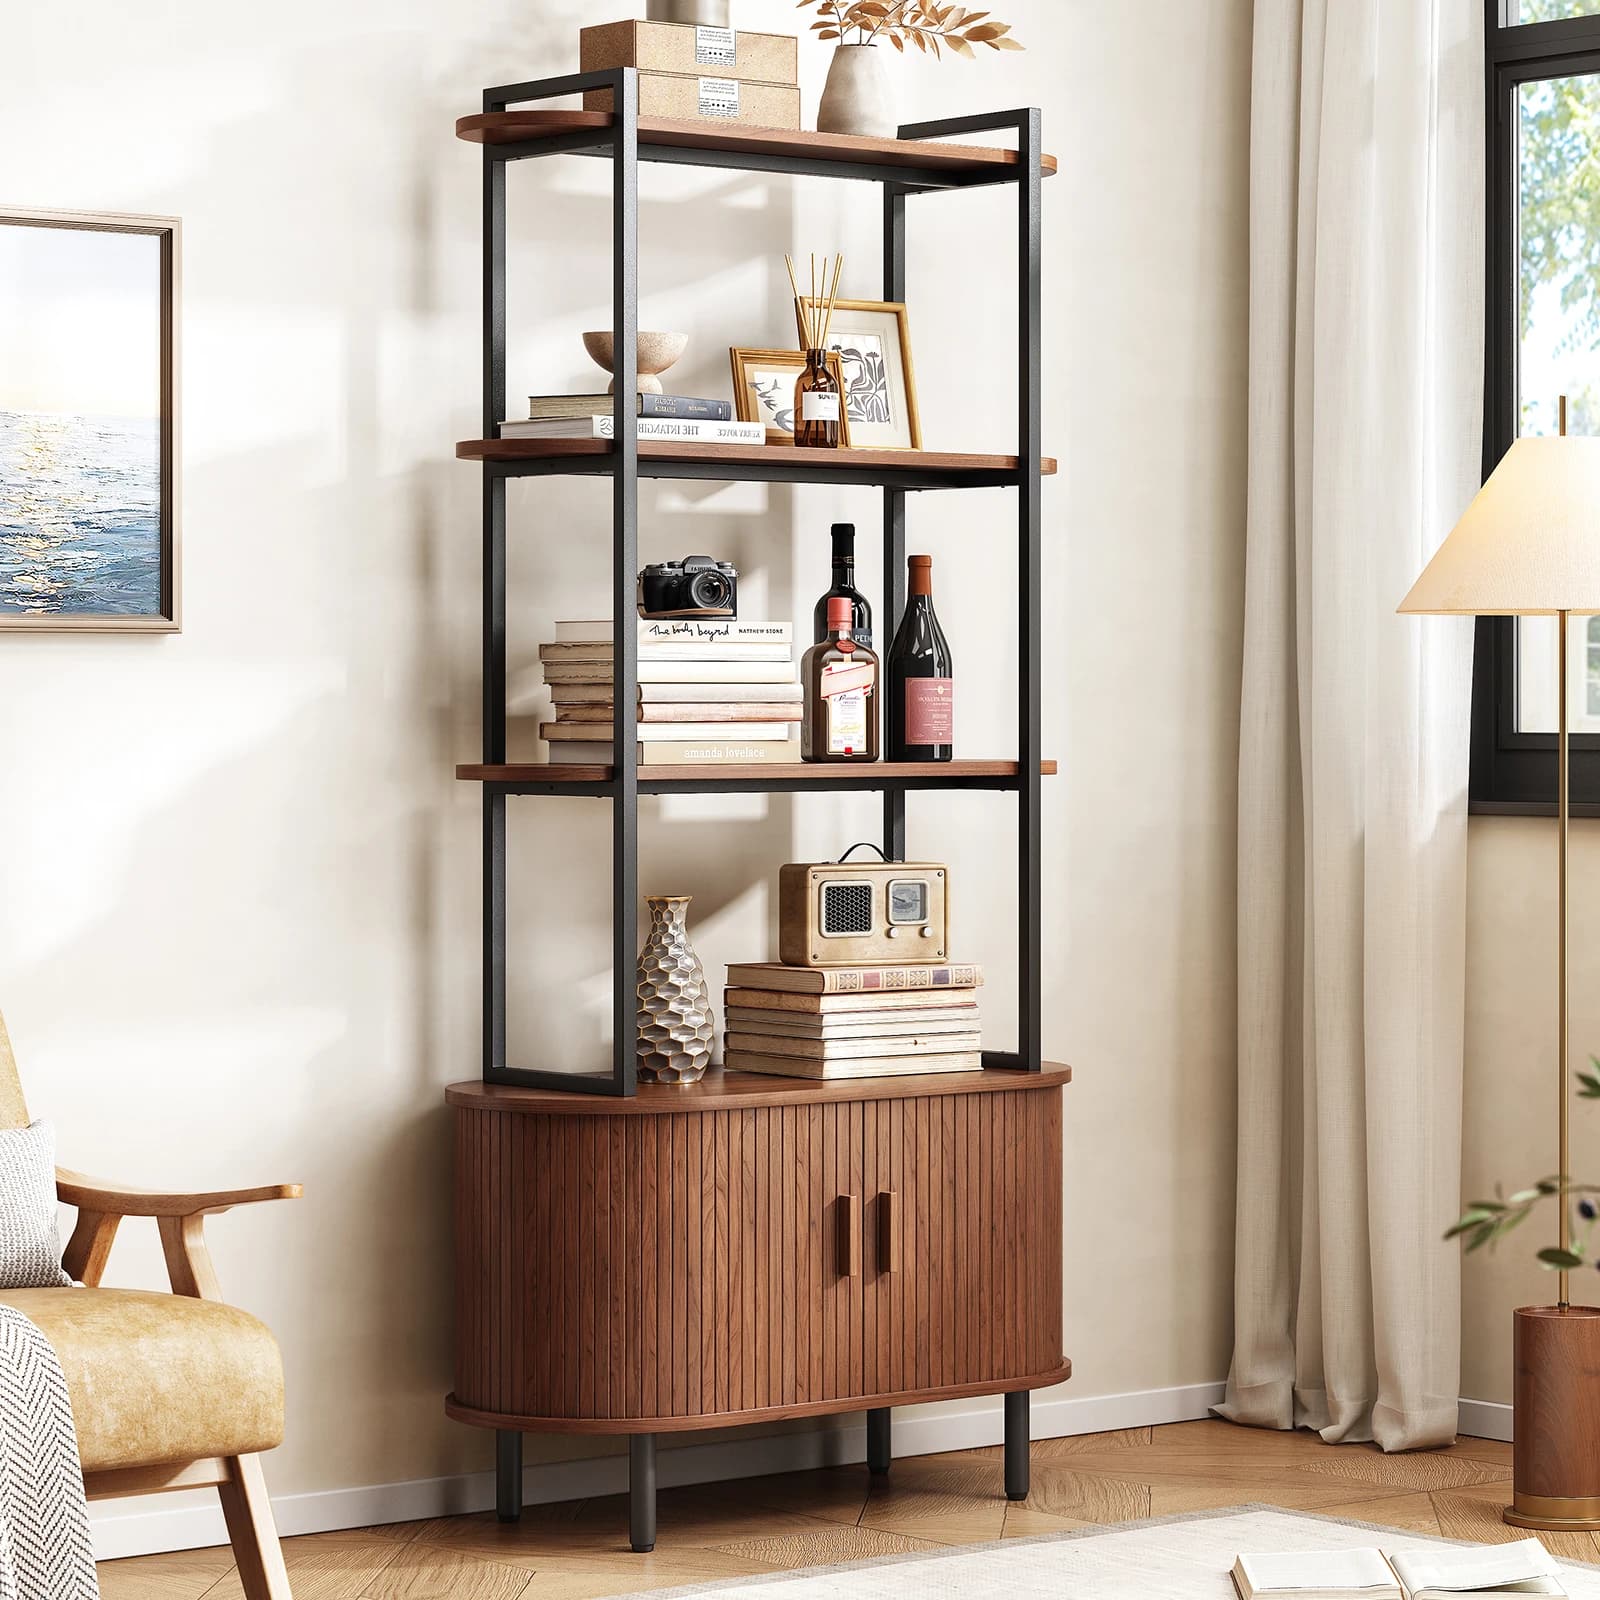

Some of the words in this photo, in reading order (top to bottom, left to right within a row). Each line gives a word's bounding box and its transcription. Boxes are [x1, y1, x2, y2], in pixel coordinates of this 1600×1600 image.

[649, 624, 670, 636] The
[684, 746, 722, 758] amanda
[725, 746, 765, 758] lovelace
